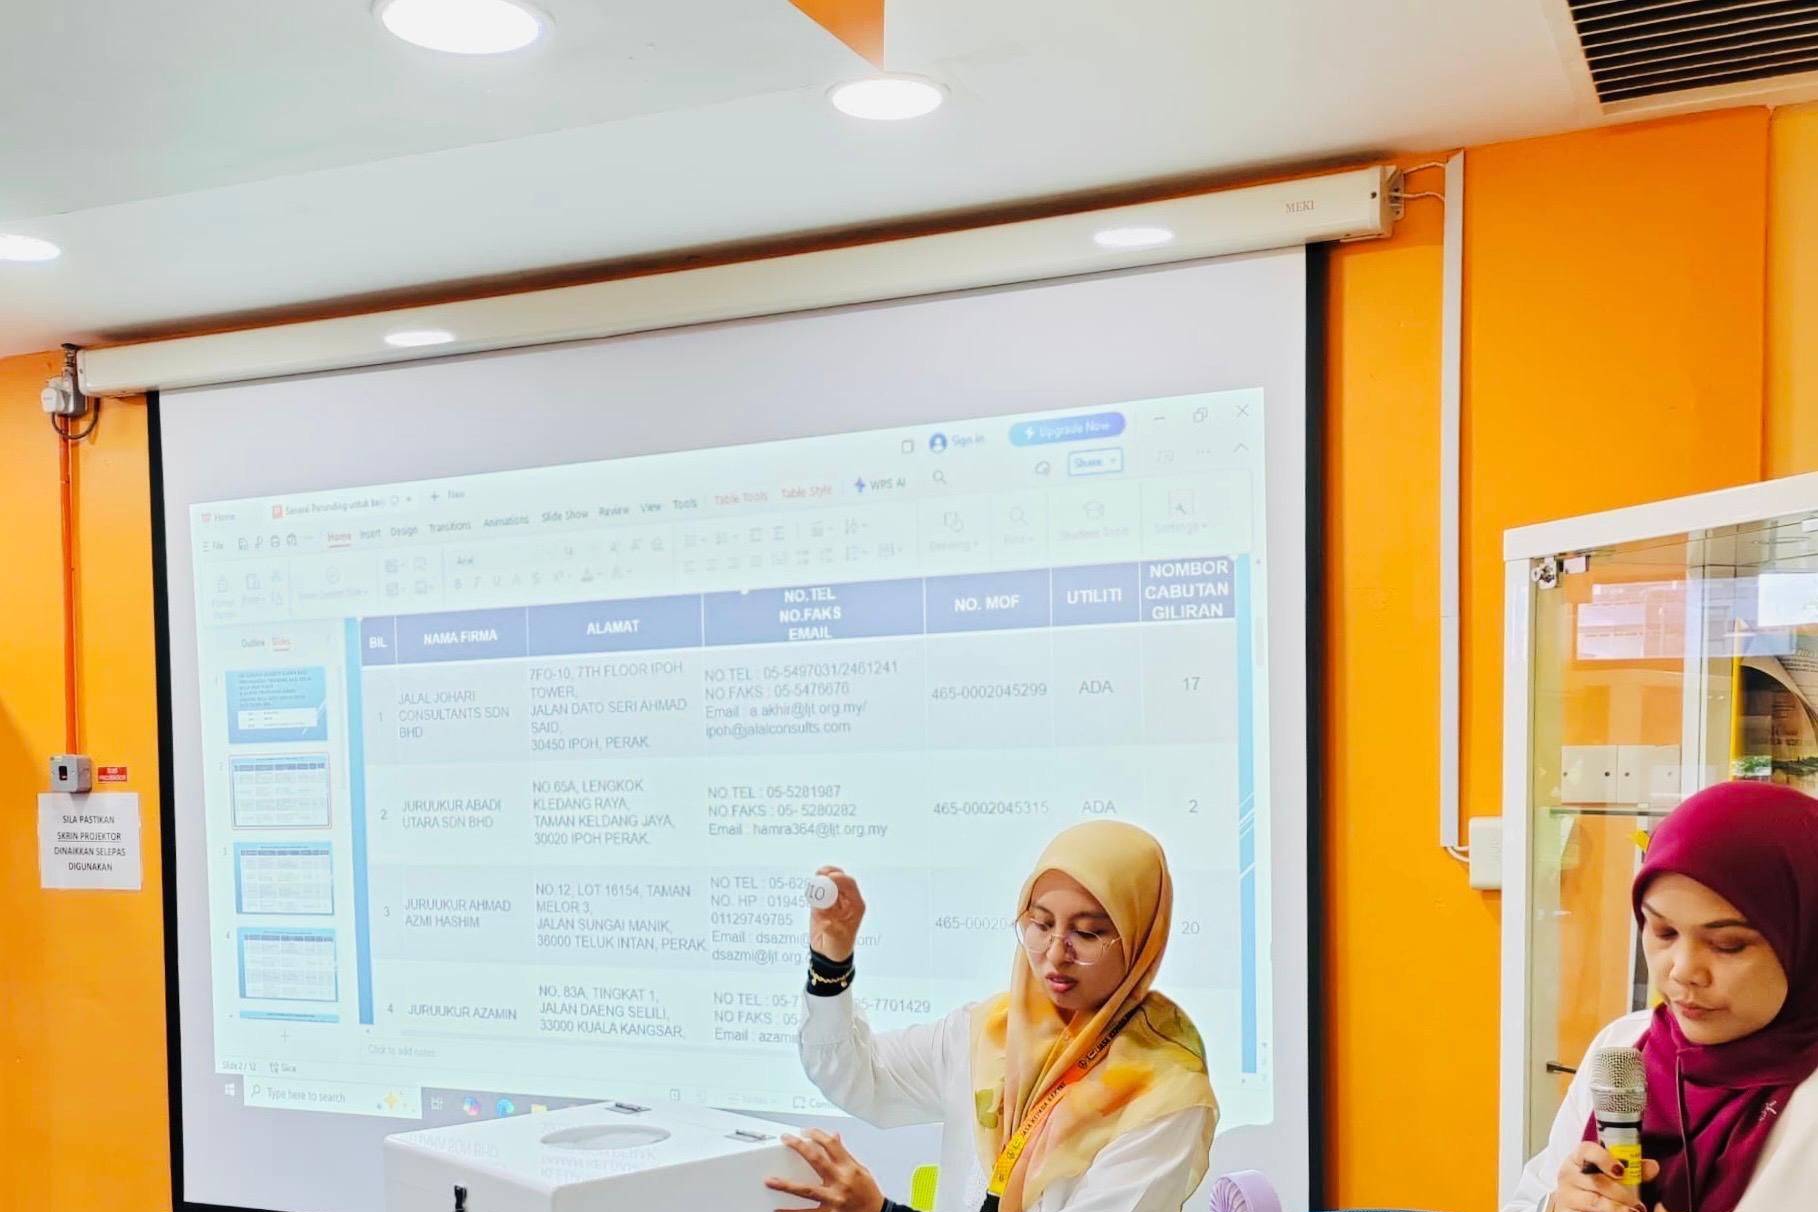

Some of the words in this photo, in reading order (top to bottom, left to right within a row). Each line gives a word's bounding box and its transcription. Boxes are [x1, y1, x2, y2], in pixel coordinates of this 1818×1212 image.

[599, 504, 630, 517] Review
[640, 502, 662, 513] View
[428, 519, 472, 534] Transitions
[483, 514, 529, 528] Animations
[390, 524, 418, 538] Design
[1150, 560, 1229, 578] NOMBOR
[1066, 588, 1123, 605] UTILITI
[1145, 582, 1229, 600] CABUTAN
[954, 597, 982, 612] NO.
[985, 594, 1020, 610] MOF
[779, 606, 842, 623] NO.FAKS
[1151, 604, 1224, 621] GILIRAN
[586, 619, 641, 636] ALAMAT
[788, 626, 833, 641] EMAIL
[369, 635, 388, 650] BIL
[423, 631, 458, 646] NAMA
[461, 628, 498, 643] FIRMA
[577, 664, 601, 679] 7TH
[603, 662, 648, 678] FLOOR
[651, 660, 683, 674] IPOH
[1079, 680, 1114, 695] ADA
[1182, 676, 1201, 692] 17
[398, 690, 430, 705] JALAL
[431, 690, 476, 704] JOHARI
[931, 682, 1048, 702] 465-0002045299
[399, 706, 482, 722] CONSULTANTS
[485, 705, 510, 719] SDN
[529, 702, 569, 716] JALAN
[571, 701, 603, 715] DATO
[608, 699, 638, 713] SERI
[640, 697, 688, 712] AHMAD
[399, 725, 424, 739] BHD
[531, 738, 566, 751] 30450
[582, 778, 644, 793] LENGKOK
[465, 798, 502, 812] ABADI
[532, 797, 593, 811] KLEDANG
[932, 801, 1049, 816] 465-0002045315
[1081, 800, 1117, 814] ADA
[1188, 800, 1199, 814] 2
[62, 815, 78, 824] SILA
[80, 815, 115, 824] PASTIKAN
[381, 809, 388, 821] 2
[402, 815, 441, 829] UTARA
[442, 815, 467, 829] SDN
[469, 815, 494, 829] BHD
[534, 814, 576, 829] TAMAN
[80, 832, 121, 841] PROJEKTOR
[708, 823, 743, 836] Email
[96, 848, 126, 857] SELEPAS
[68, 862, 113, 871] DIGUNAKAN
[577, 883, 602, 897] LOT
[647, 884, 691, 898] TAMAN
[383, 906, 391, 918] 3
[468, 899, 512, 913] AHMAD
[536, 900, 577, 914] MELOR
[405, 915, 432, 928] AZMI
[434, 915, 481, 928] HASHIM
[536, 917, 575, 931] JALAN
[577, 918, 625, 932] SUNGAI
[1180, 920, 1201, 936] 20
[574, 935, 615, 949] TELUK
[711, 930, 746, 944] Email
[538, 984, 562, 998] NO.
[593, 987, 645, 1001] TINGKAT
[472, 1006, 518, 1020] AZAMIN
[538, 1002, 578, 1016] JALAN
[580, 1003, 625, 1018] DAENG
[539, 1019, 574, 1033] 33000
[577, 1020, 618, 1035] KUALA
[714, 1028, 749, 1042] Email
